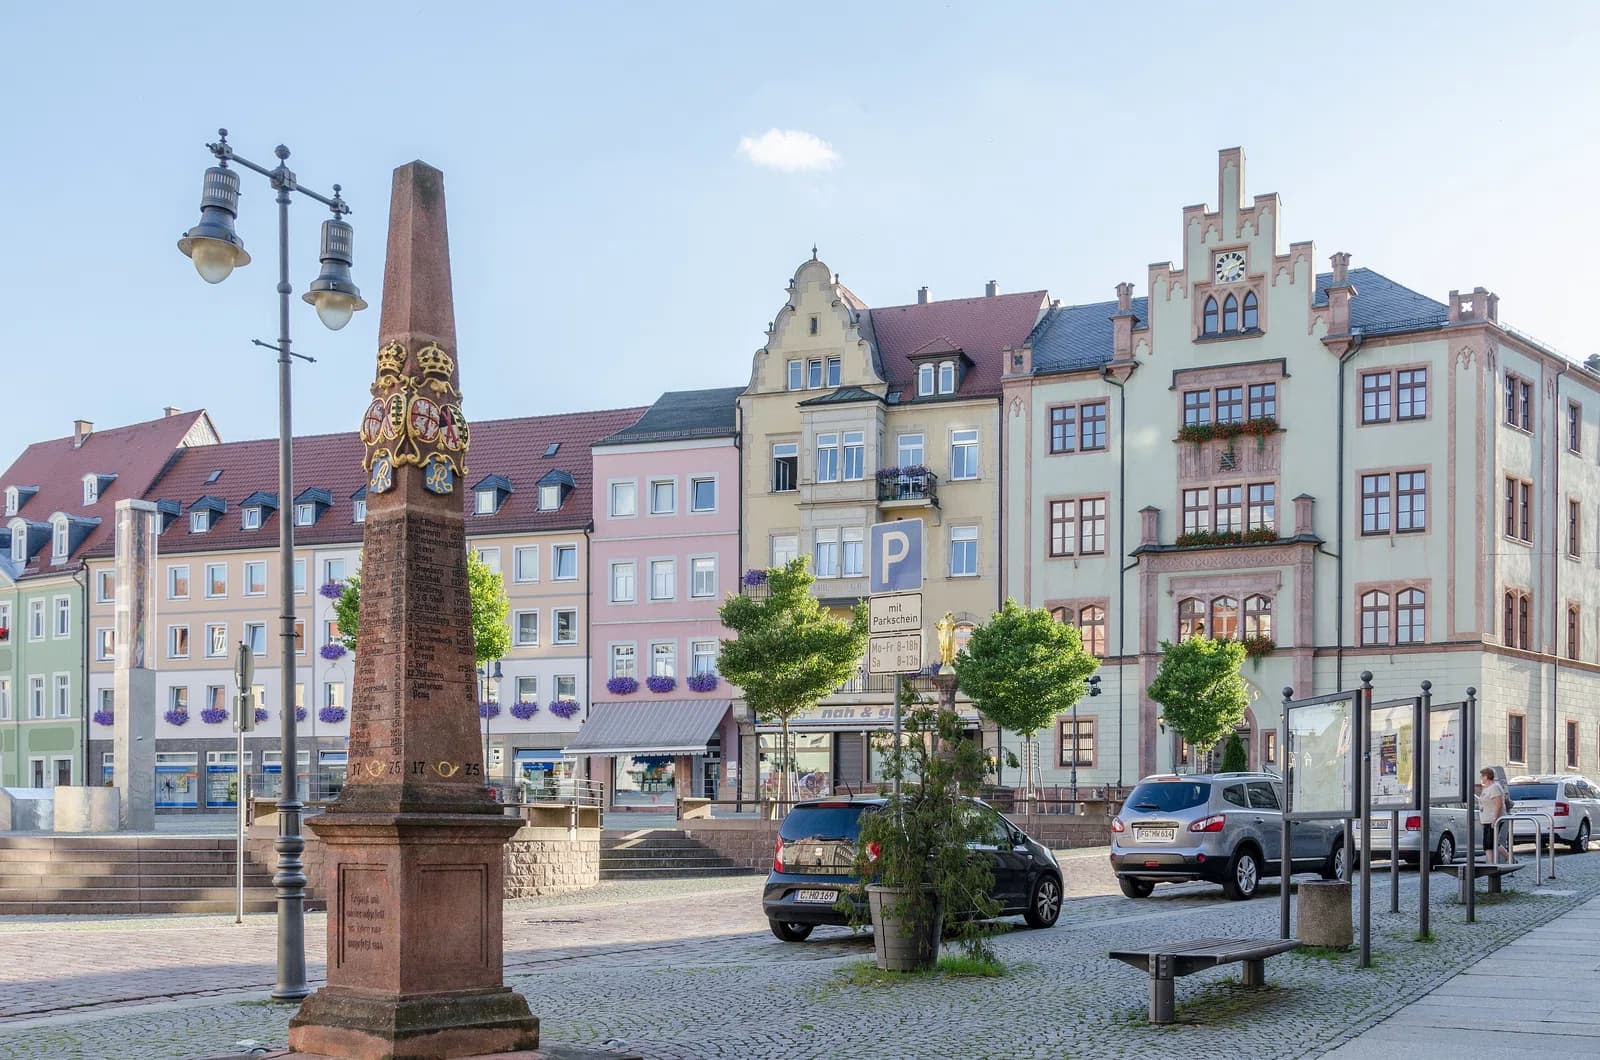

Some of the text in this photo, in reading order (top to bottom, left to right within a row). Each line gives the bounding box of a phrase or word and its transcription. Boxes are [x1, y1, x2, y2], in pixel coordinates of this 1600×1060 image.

[882, 531, 910, 584] P
[888, 603, 902, 613] mit
[873, 614, 918, 626] Parkschein
[872, 640, 918, 654] Mo-Fr 8-18h
[872, 656, 918, 668] Sa 8-13h
[411, 761, 480, 776] 17 25
